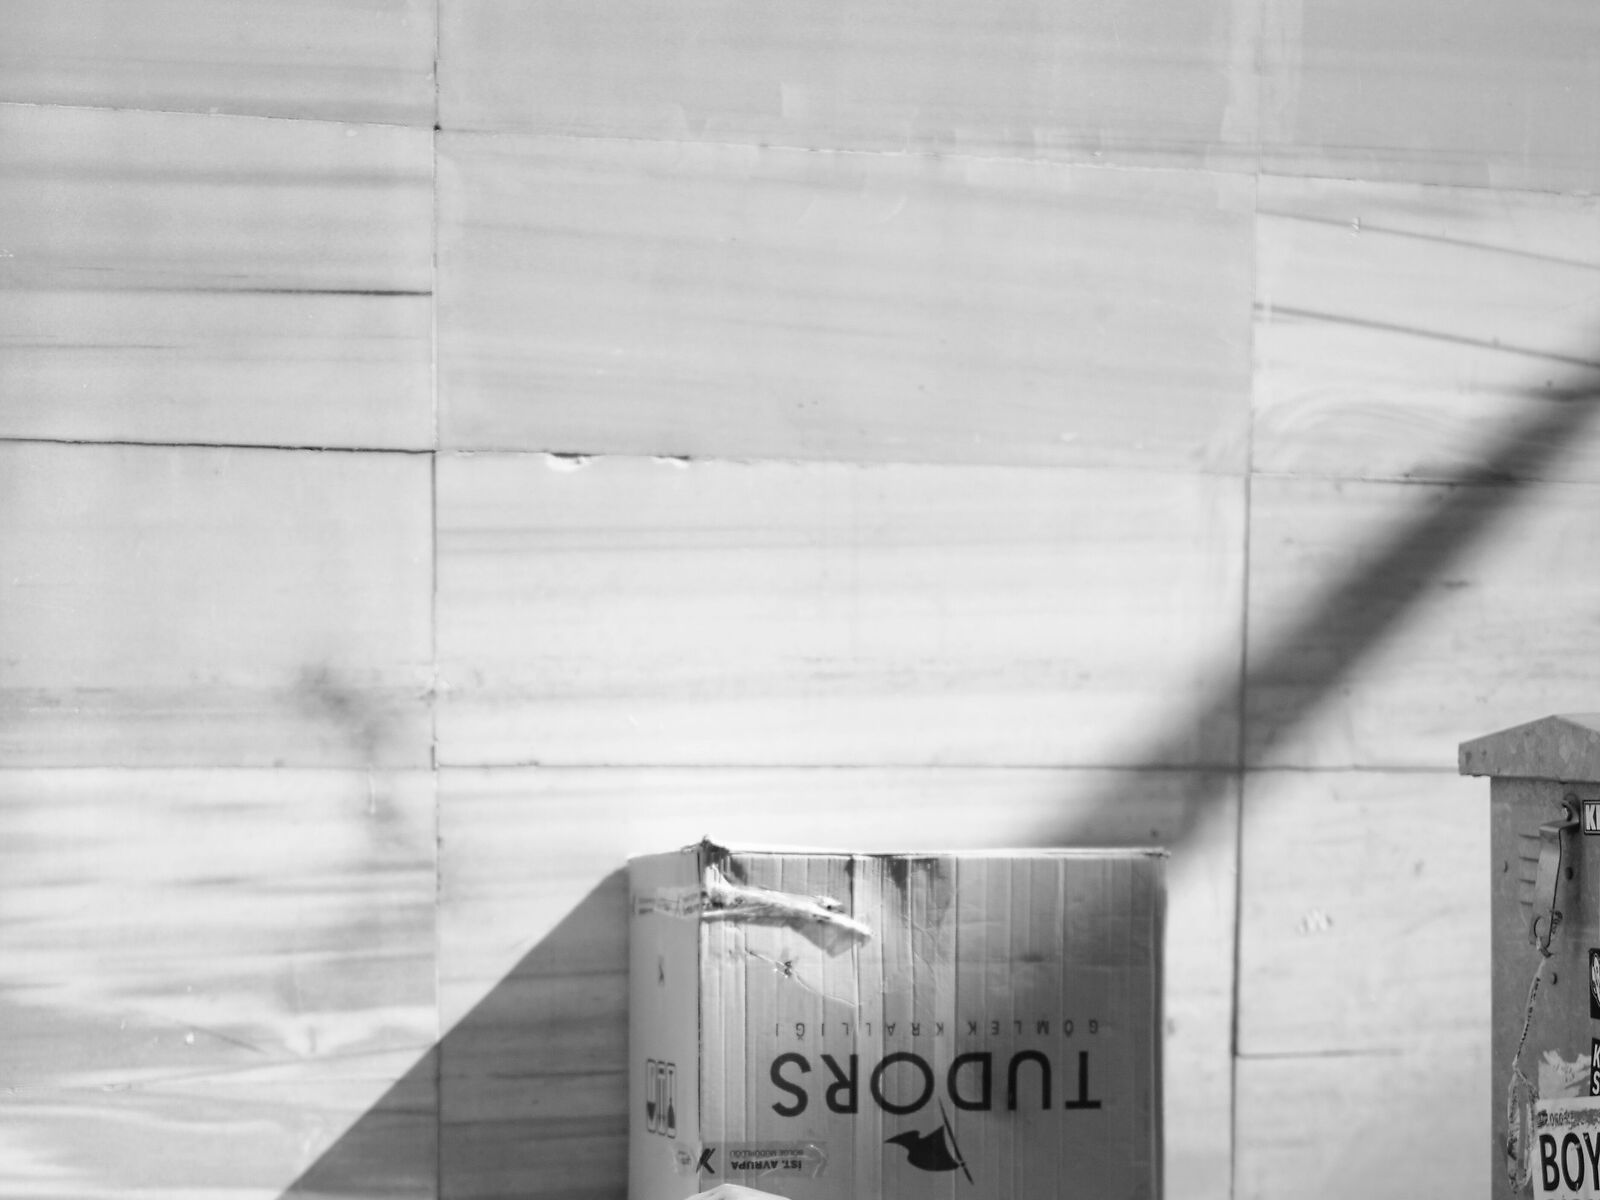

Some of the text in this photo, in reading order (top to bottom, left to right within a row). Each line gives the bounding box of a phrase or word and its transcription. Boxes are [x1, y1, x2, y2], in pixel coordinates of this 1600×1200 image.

[967, 1019, 1098, 1039] GÖMLEK
[769, 1050, 1102, 1117] TUDORS
[730, 1160, 778, 1171] AVRUPA
